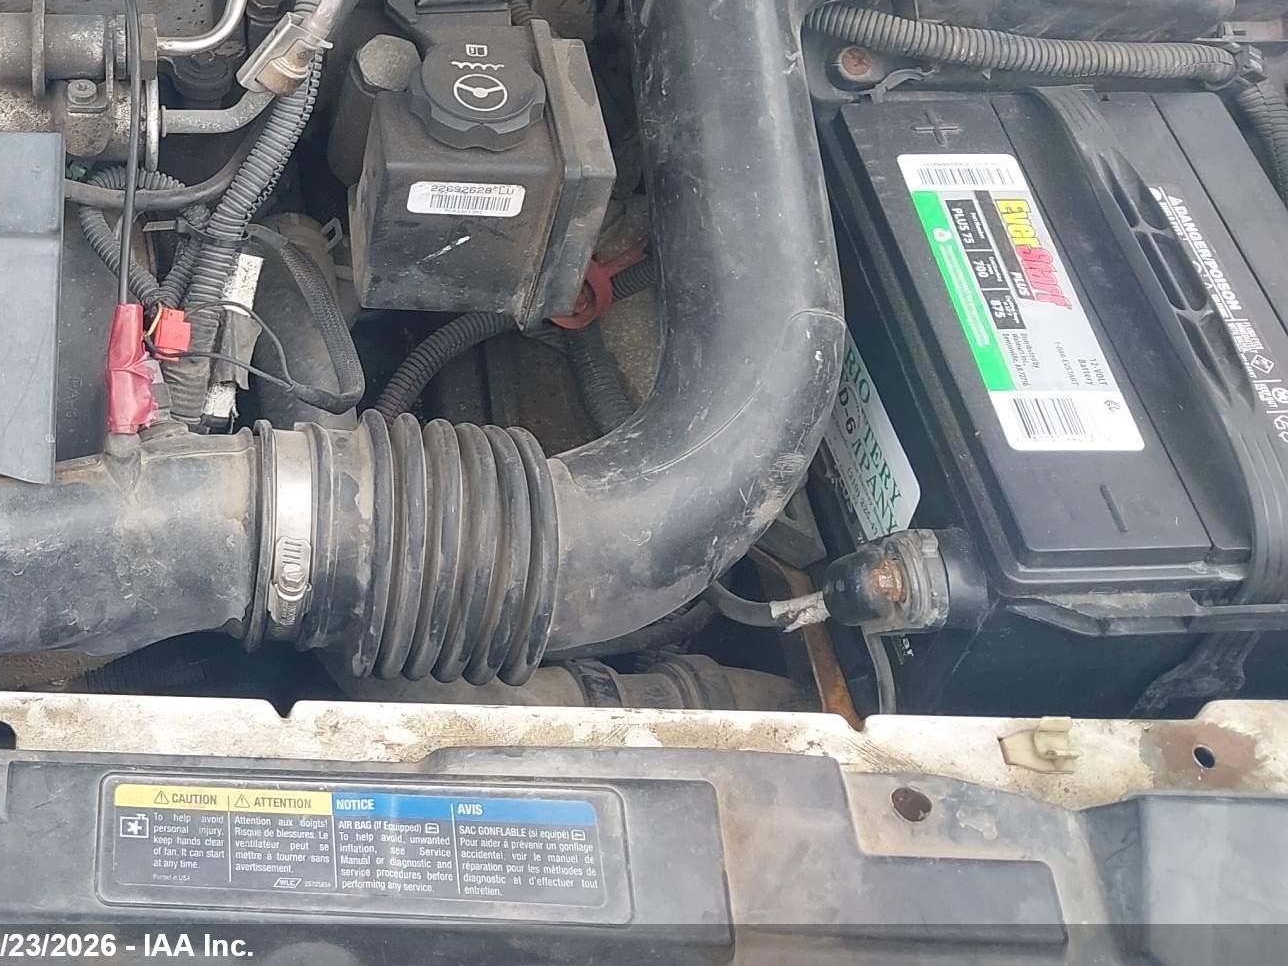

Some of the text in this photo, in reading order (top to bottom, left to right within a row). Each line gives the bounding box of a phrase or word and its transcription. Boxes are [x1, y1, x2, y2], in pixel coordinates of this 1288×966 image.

[951, 207, 975, 244] PLUS 75
[1175, 206, 1243, 310] DANGER/POISON
[973, 260, 989, 278] 700
[1009, 271, 1031, 297] PLUS
[1077, 358, 1095, 386] Battery
[172, 793, 217, 805] CAUTION
[253, 796, 312, 809] ATTENTION
[336, 798, 375, 811] NOTICE
[457, 803, 483, 815] AVIS
[153, 812, 224, 824] To help avoid
[234, 815, 328, 830] Attention aux doigts!
[153, 824, 189, 834] personal
[234, 826, 262, 838] Risque
[263, 828, 274, 837] de
[318, 831, 329, 840] Le
[338, 820, 422, 834] AIR BAG (If Equipped)
[459, 825, 538, 839] SAC GONFLABLE (si
[153, 835, 224, 847] keep hands clear
[339, 831, 451, 845] To help unwanted
[235, 839, 330, 852] ventilateur peut se
[339, 843, 452, 857] inflation, see Service
[460, 837, 593, 854] Pour aider à prévenir un gonflage
[153, 847, 161, 856] of
[181, 848, 187, 857] It
[189, 849, 204, 857] can
[206, 849, 225, 859] start
[235, 851, 331, 864] mettre à tourner sans
[460, 850, 595, 865] accidentel, voir le manuel de
[153, 859, 200, 870] at any time.
[340, 855, 453, 869] Manual or diagnostic and
[461, 861, 597, 877] réparation pour les méthodes de
[340, 868, 454, 882] service procedures before
[463, 873, 598, 889] diagnostic et d'effectuer tout
[341, 879, 386, 891] performing
[387, 881, 402, 892] any
[403, 882, 435, 893] service.
[464, 885, 503, 897] entretien.
